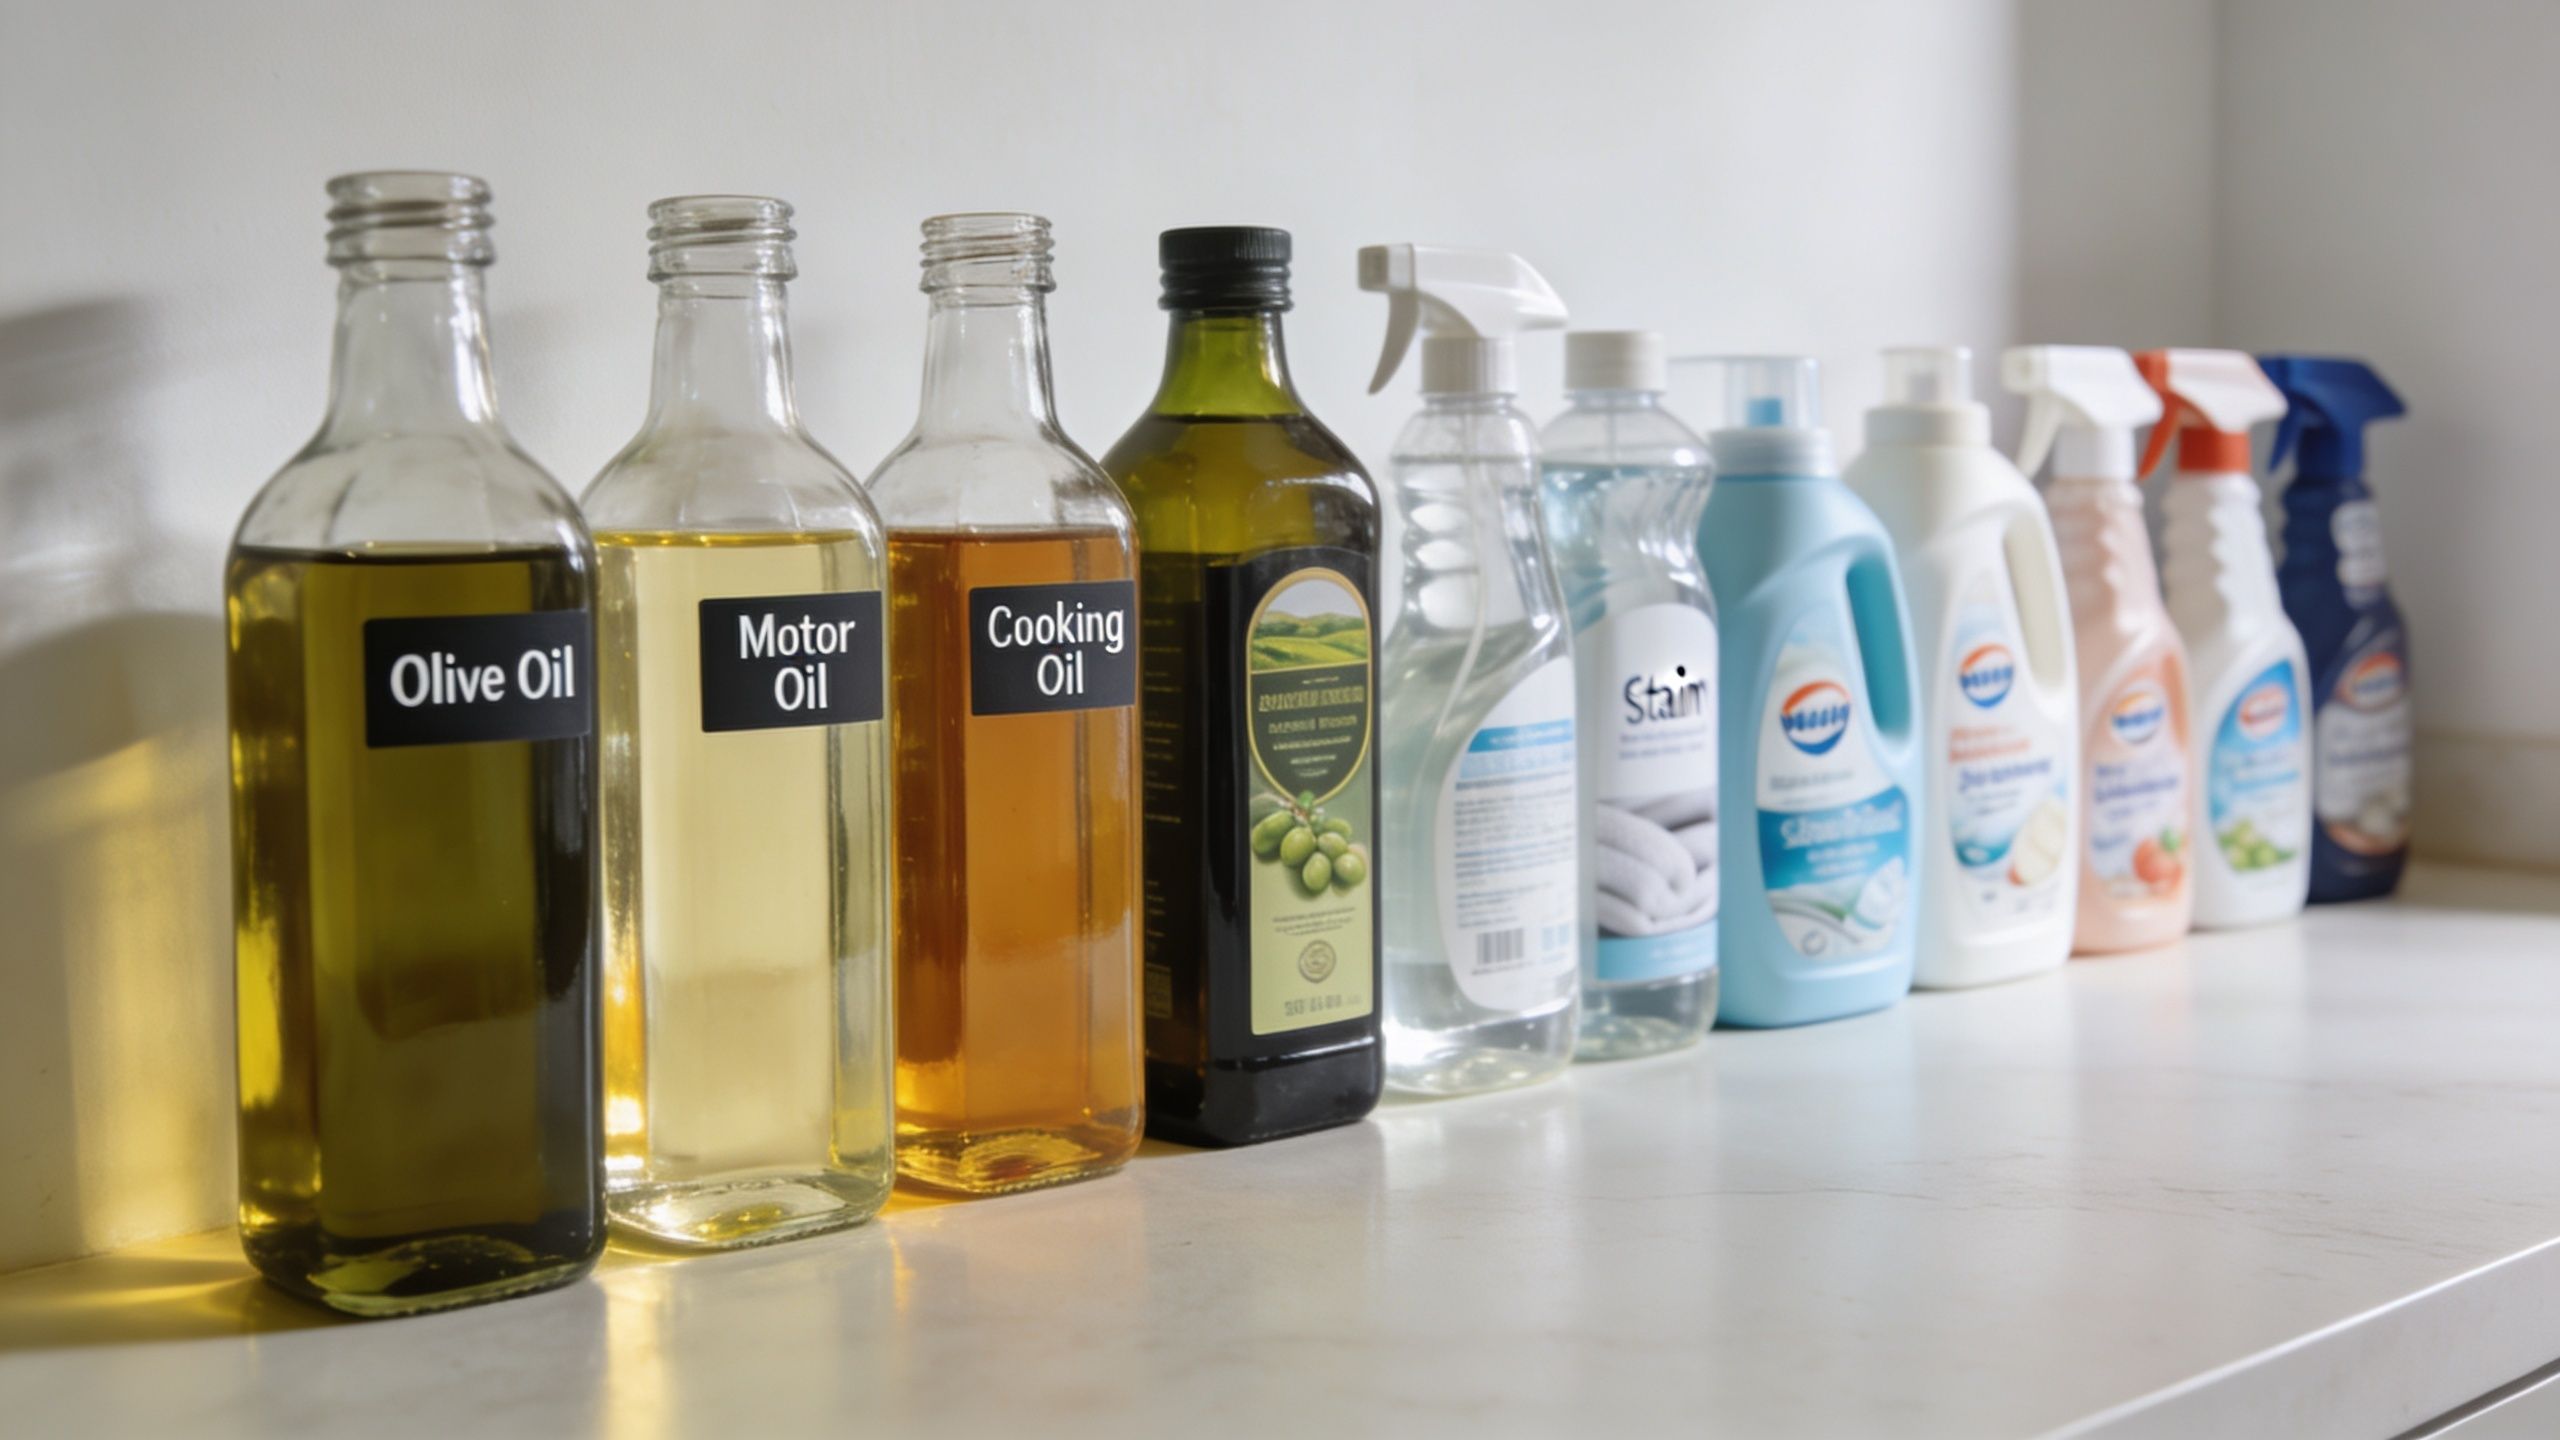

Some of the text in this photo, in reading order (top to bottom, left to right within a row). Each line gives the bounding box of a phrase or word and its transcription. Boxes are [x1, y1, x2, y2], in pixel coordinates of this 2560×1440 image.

[739, 613, 856, 659] Motor
[988, 600, 1126, 655] Cooking
[390, 645, 575, 708] Olive Oil
[774, 662, 829, 711] Oil
[1036, 649, 1085, 696] Oil
